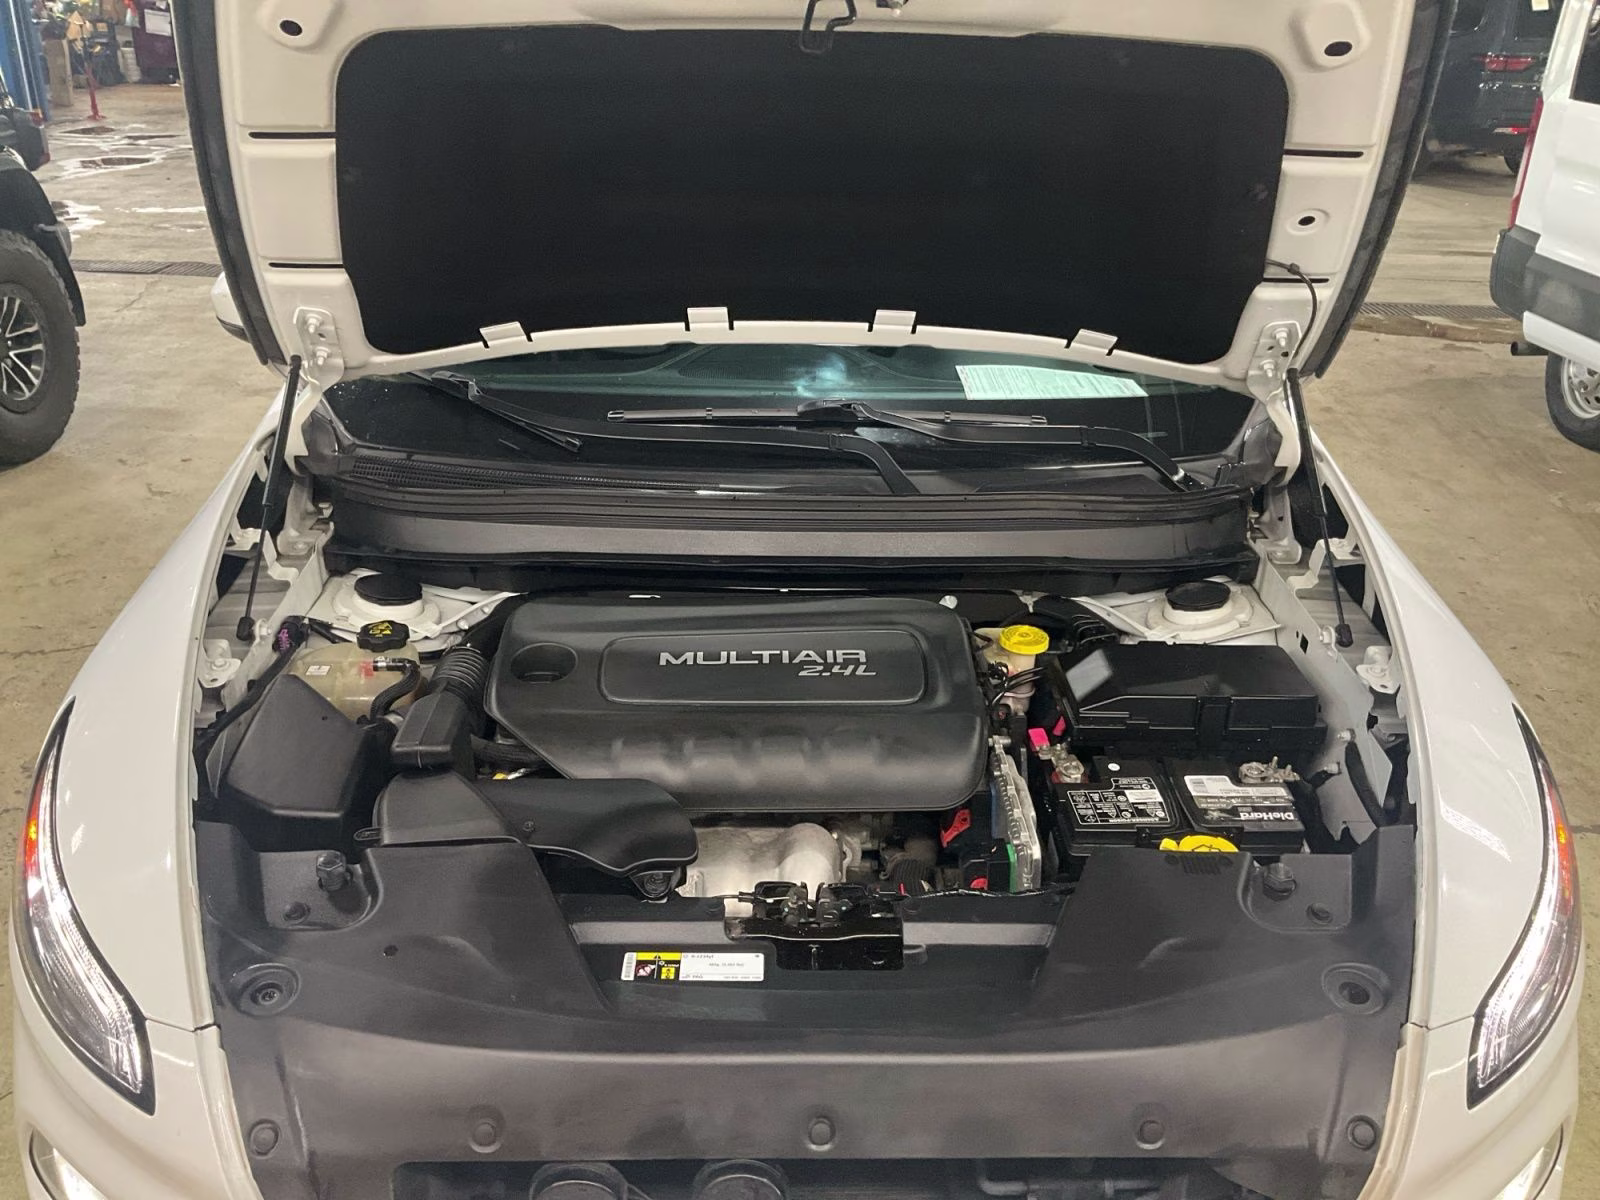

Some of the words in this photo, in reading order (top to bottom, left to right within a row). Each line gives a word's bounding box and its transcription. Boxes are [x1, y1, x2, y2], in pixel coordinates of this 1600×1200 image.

[659, 649, 867, 666] MULTIAIR
[798, 665, 877, 676] 2.4L
[1239, 811, 1295, 821] DieHard
